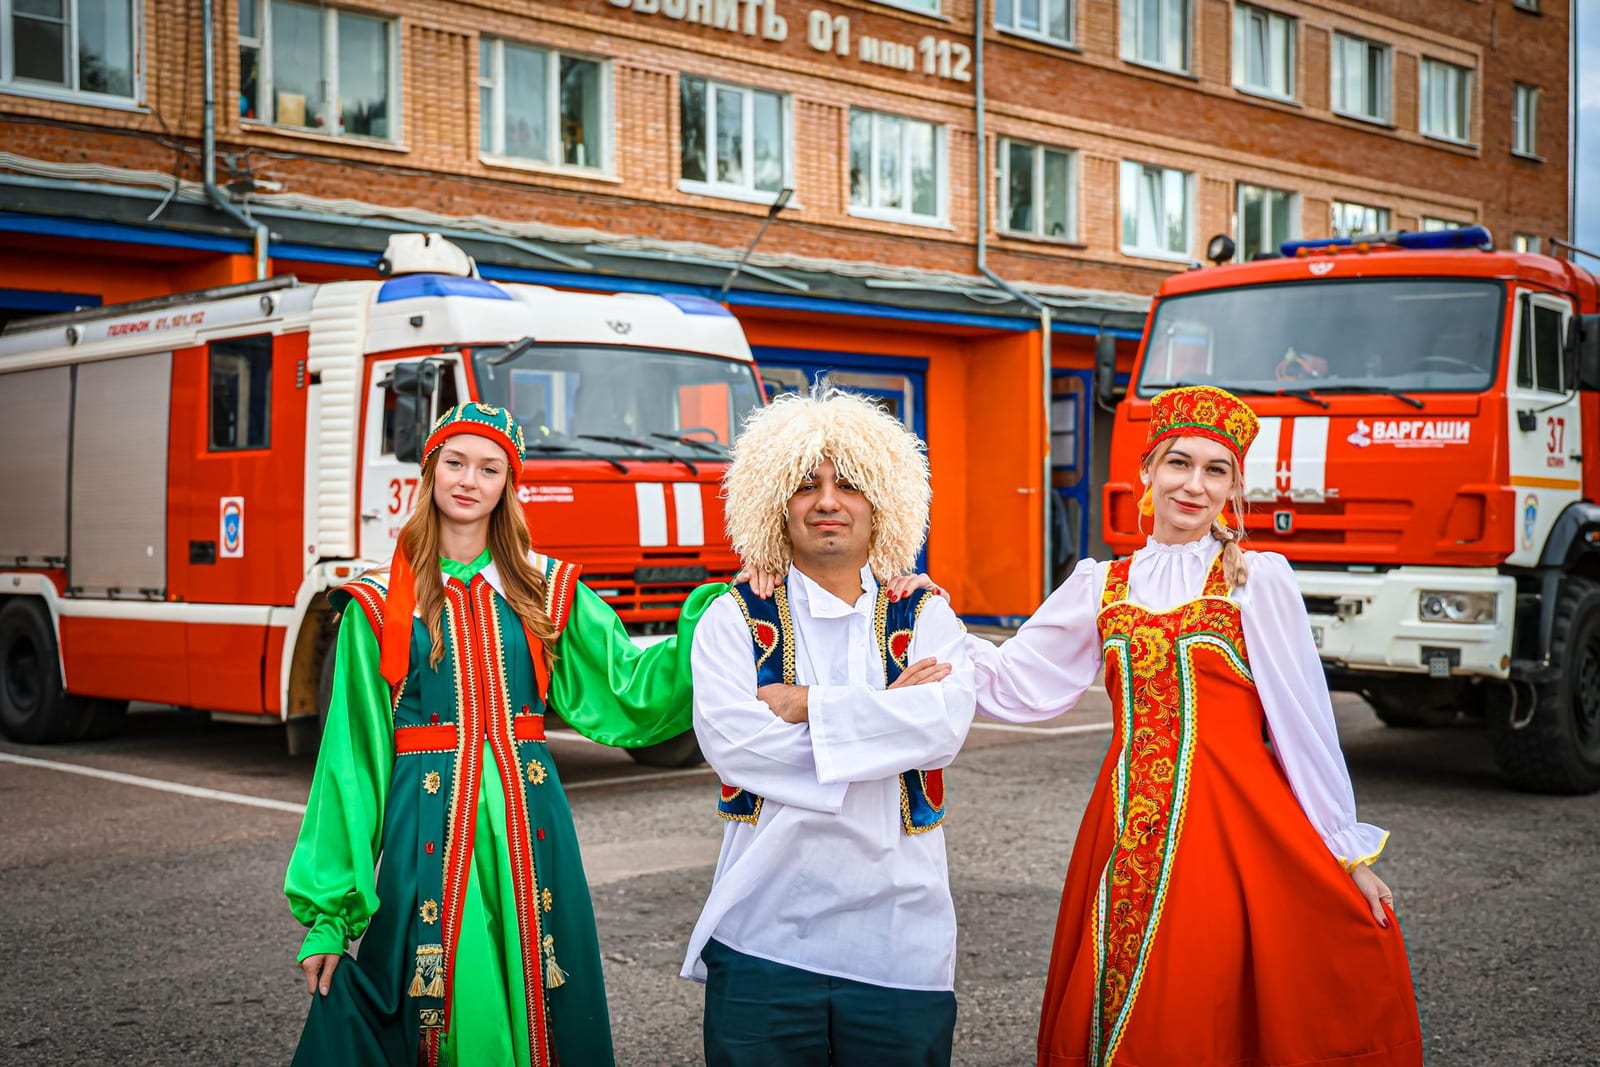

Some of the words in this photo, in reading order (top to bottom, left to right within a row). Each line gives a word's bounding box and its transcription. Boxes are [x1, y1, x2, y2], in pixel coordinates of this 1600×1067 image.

[809, 9, 850, 56] 01
[859, 35, 915, 71] или
[919, 35, 972, 82] 112
[1372, 421, 1470, 440] ВАРГАШИ
[1547, 416, 1565, 453] 37
[388, 478, 419, 515] 37
